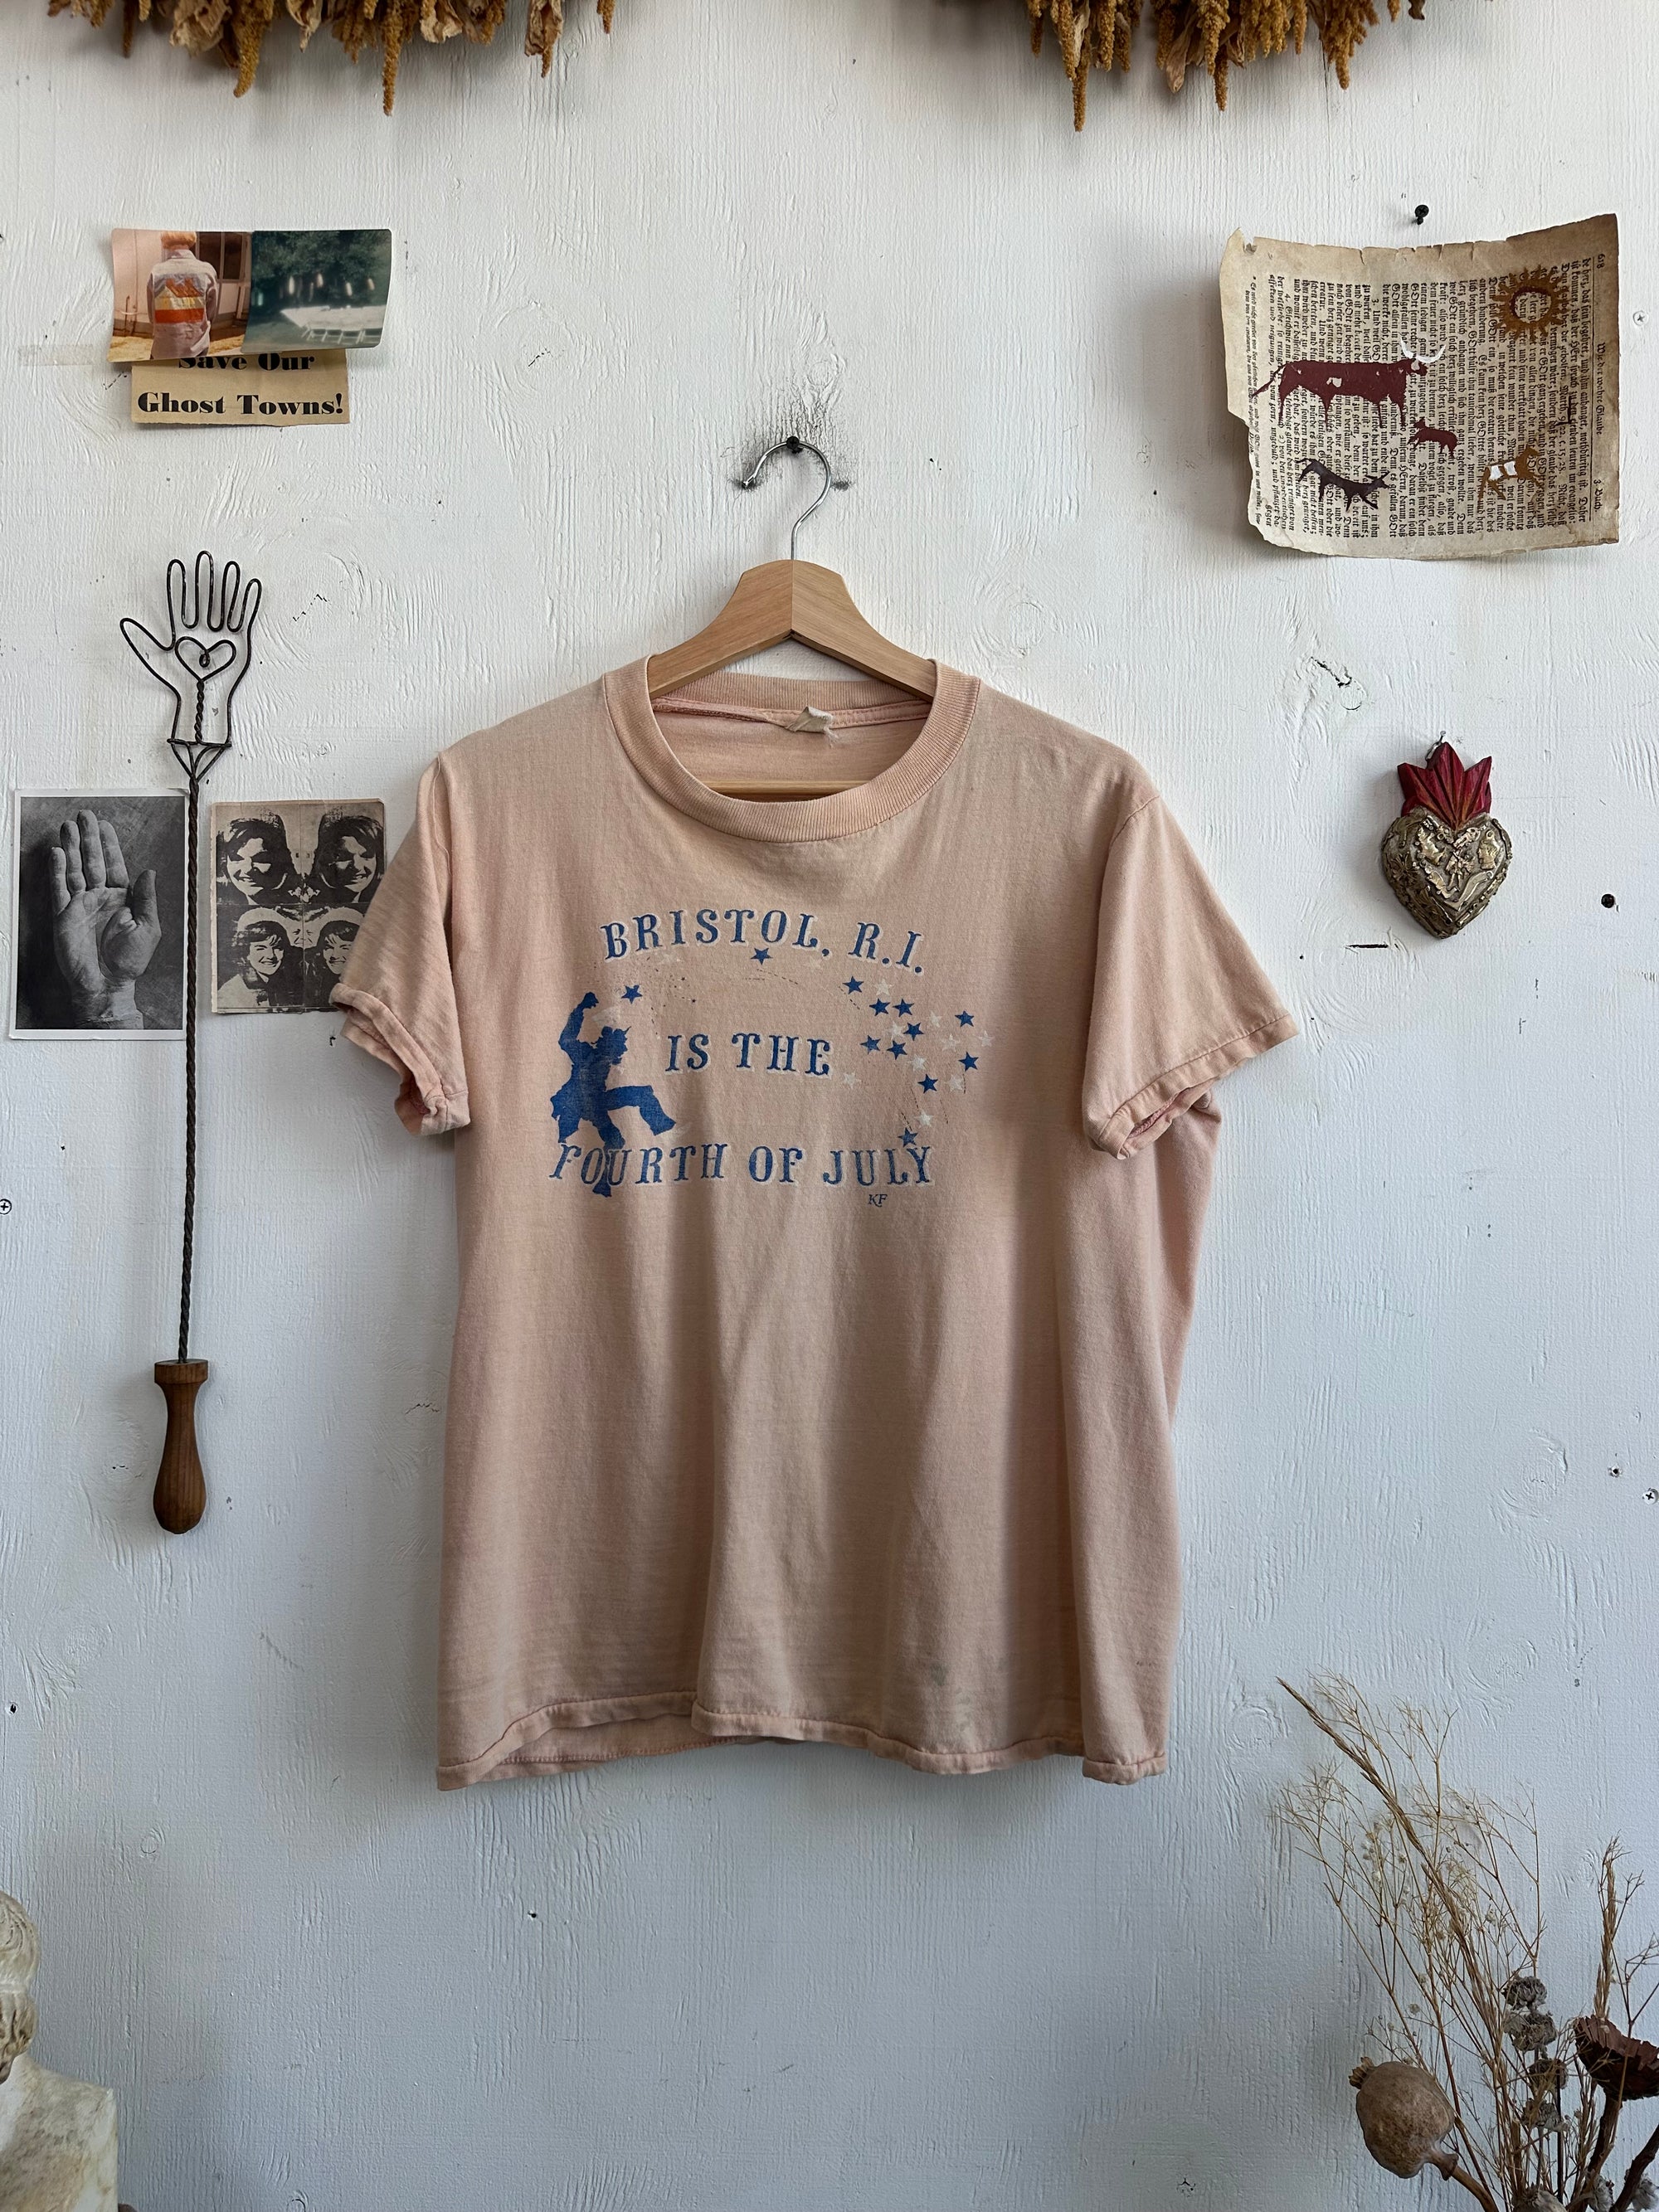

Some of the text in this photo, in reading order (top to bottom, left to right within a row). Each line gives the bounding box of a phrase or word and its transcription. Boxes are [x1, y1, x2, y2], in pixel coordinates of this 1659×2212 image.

[178, 352, 315, 371] Save Our
[138, 392, 343, 415] Ghost Towns!
[1594, 489, 1603, 512] Buch.
[601, 909, 923, 975] BRISTOL, R.I.
[665, 1032, 832, 1077] IS THE
[549, 1142, 932, 1186] FOURTH OF JULY
